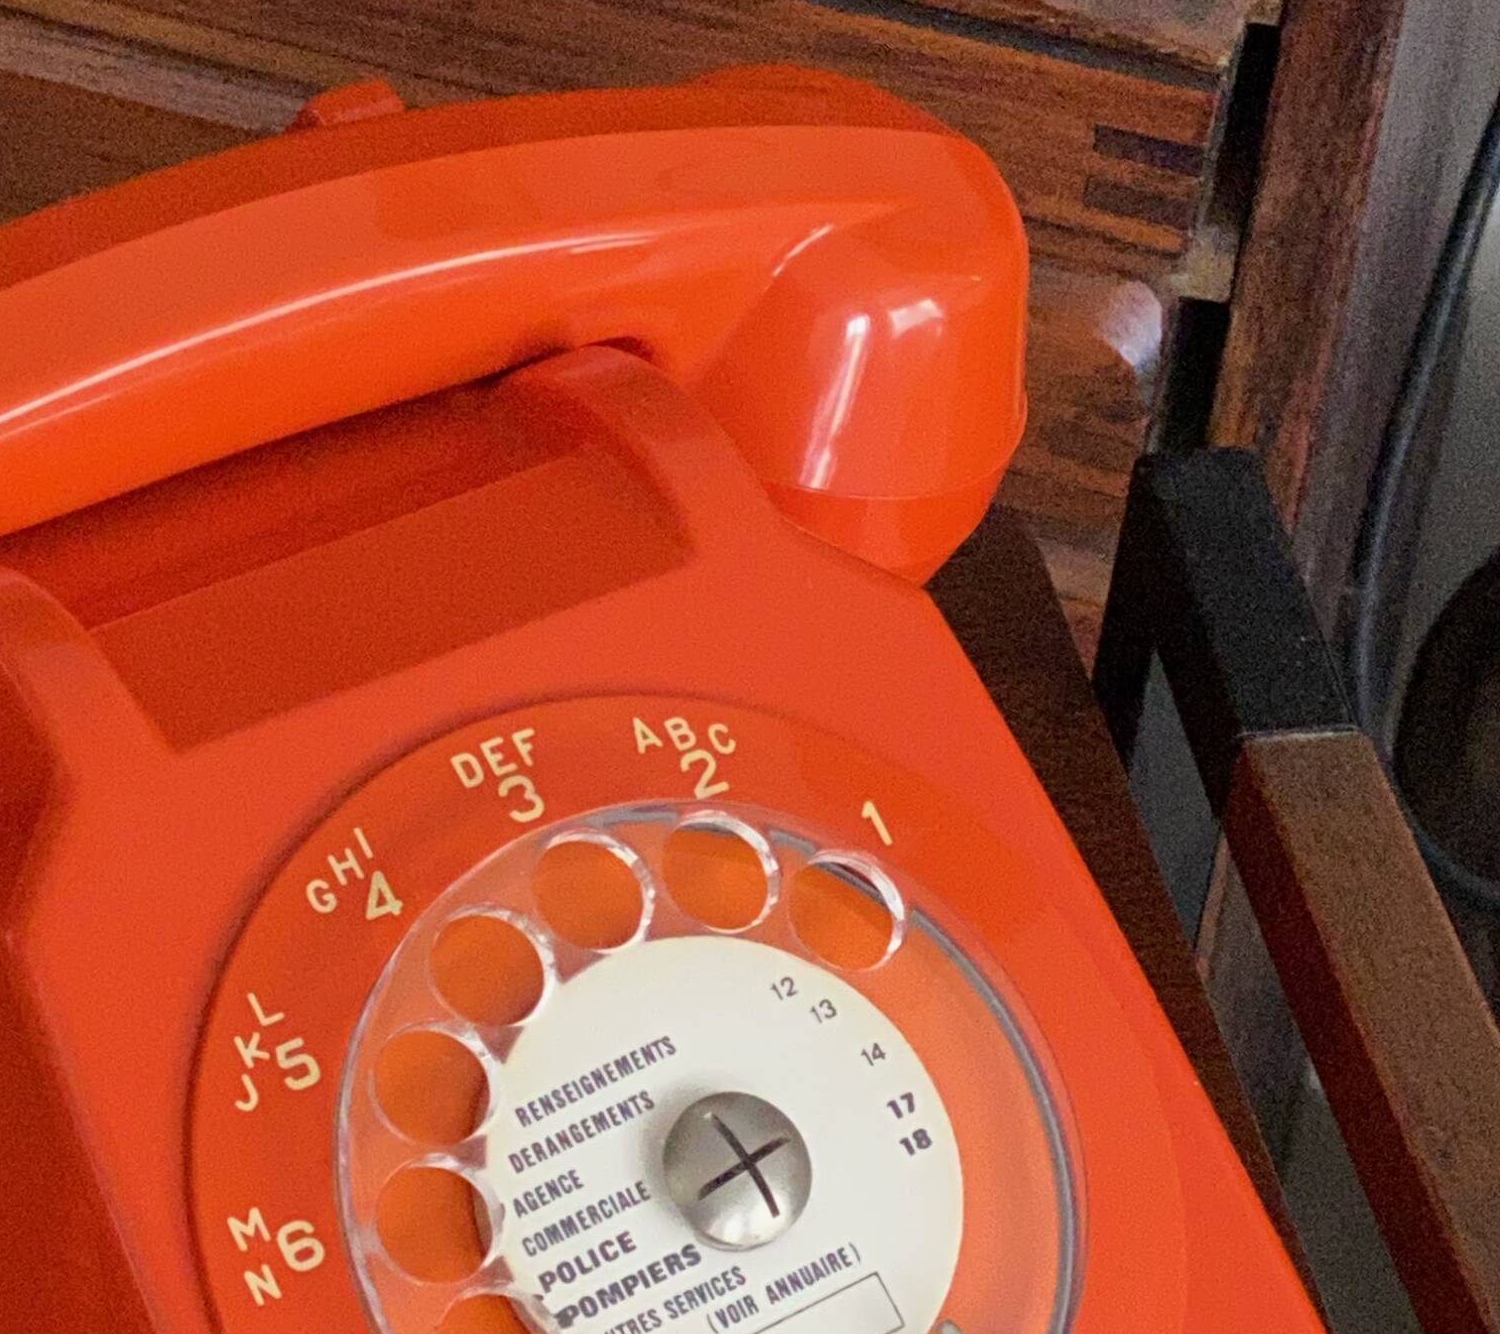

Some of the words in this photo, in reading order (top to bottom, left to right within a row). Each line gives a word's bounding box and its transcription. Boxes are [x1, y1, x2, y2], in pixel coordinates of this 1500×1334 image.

[451, 729, 534, 787] DEF
[633, 717, 735, 753] ABC
[499, 776, 544, 822] 3
[681, 750, 729, 799] 2
[862, 801, 892, 844] 1
[307, 828, 372, 912] GHI
[367, 872, 402, 919] 4
[770, 977, 798, 1001] 12
[809, 999, 838, 1024] 13
[276, 1038, 320, 1089] 5
[860, 1042, 887, 1067] 14
[514, 1035, 678, 1128] RENSEIGNEMENTS
[886, 1092, 917, 1119] 17
[508, 1090, 656, 1174] DERANGEMENTS
[899, 1128, 933, 1156] 18
[512, 1169, 585, 1218] AGENCE
[521, 1180, 651, 1258] COMMERCIALE
[277, 1221, 324, 1271] 6
[537, 1231, 637, 1294] POLICE
[556, 1243, 702, 1328] POMPIERS
[665, 1266, 748, 1322] SERVICES
[706, 1295, 760, 1334] (VOIR
[767, 1242, 862, 1305] ANNUAIRE)
